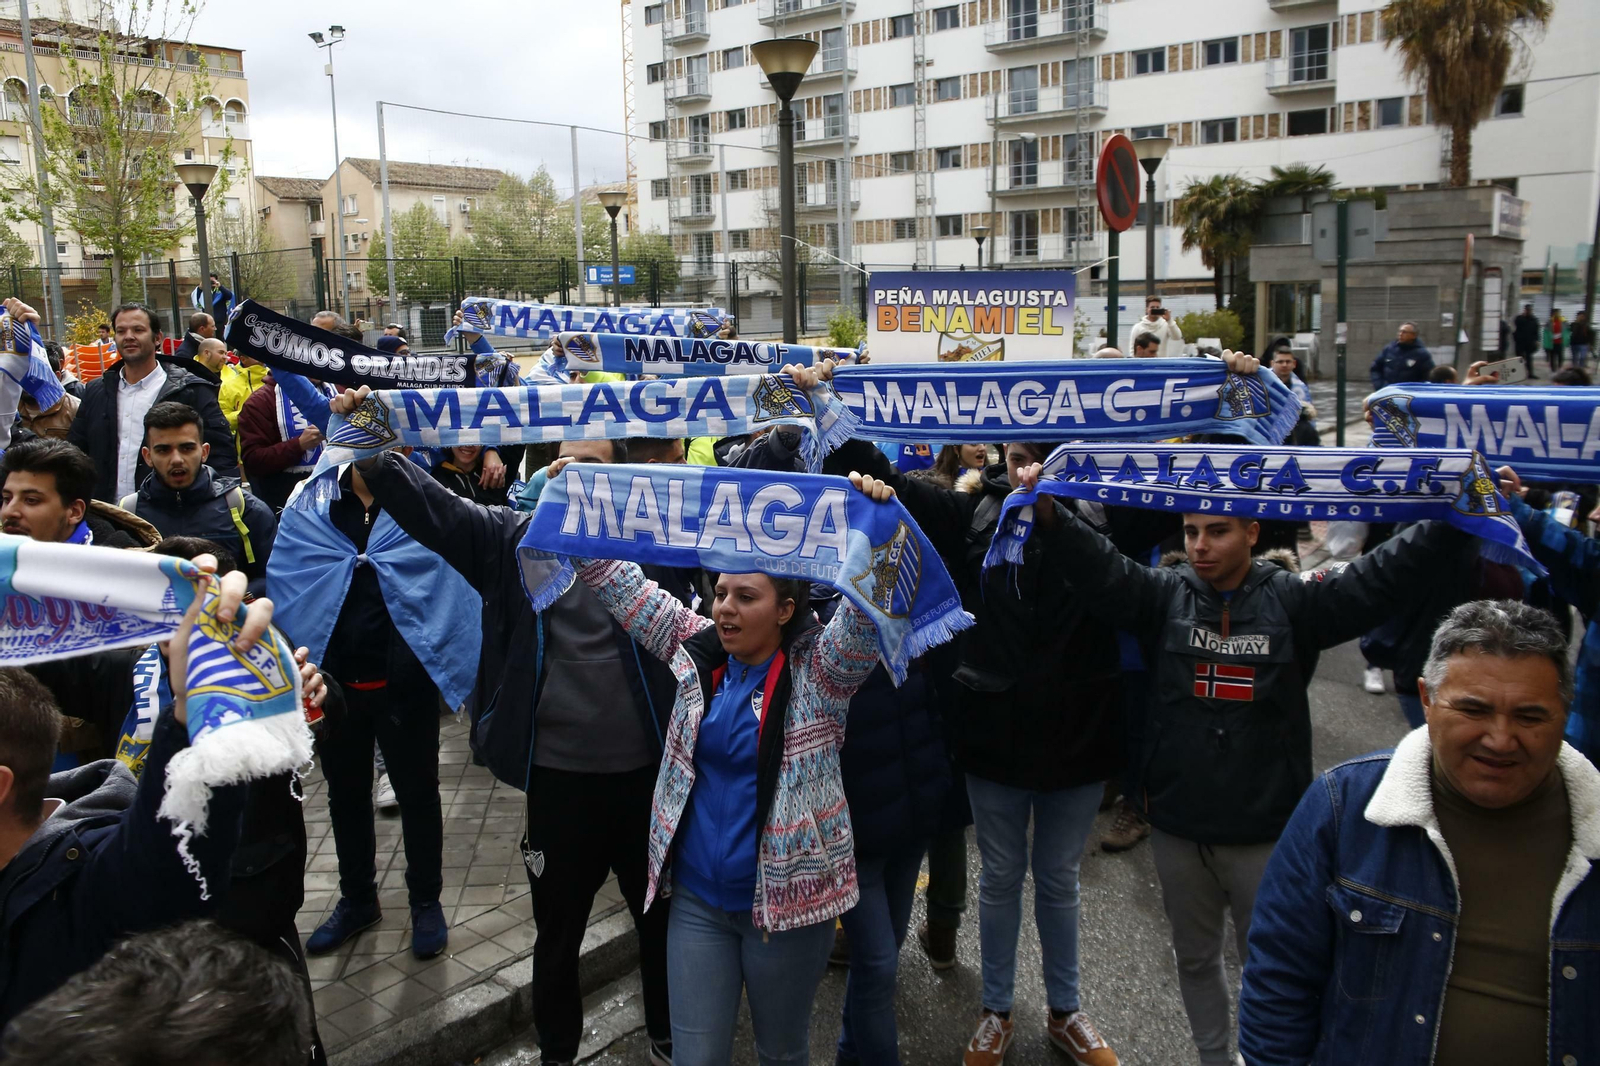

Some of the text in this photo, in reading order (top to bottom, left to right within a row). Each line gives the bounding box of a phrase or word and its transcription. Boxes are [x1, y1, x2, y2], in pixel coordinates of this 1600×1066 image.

[874, 286, 1068, 307] PEÑA MALAGUISTA
[500, 305, 678, 337] MALAGA
[876, 305, 1064, 335] BENAMIEL
[248, 326, 468, 382] SOMOS GRANDES
[400, 379, 738, 433] MALAGA
[862, 379, 1087, 425] MALAGA
[1443, 403, 1600, 460] MAL
[1055, 452, 1443, 495] MALAGA C.F.
[560, 469, 850, 563] MALAGA
[1097, 487, 1384, 517] CLUB DE FUTBOL
[754, 557, 839, 580] CLUB DE FUTB
[1191, 628, 1266, 655] NORWAY
[1208, 632, 1265, 643] GEORAPHICAL
